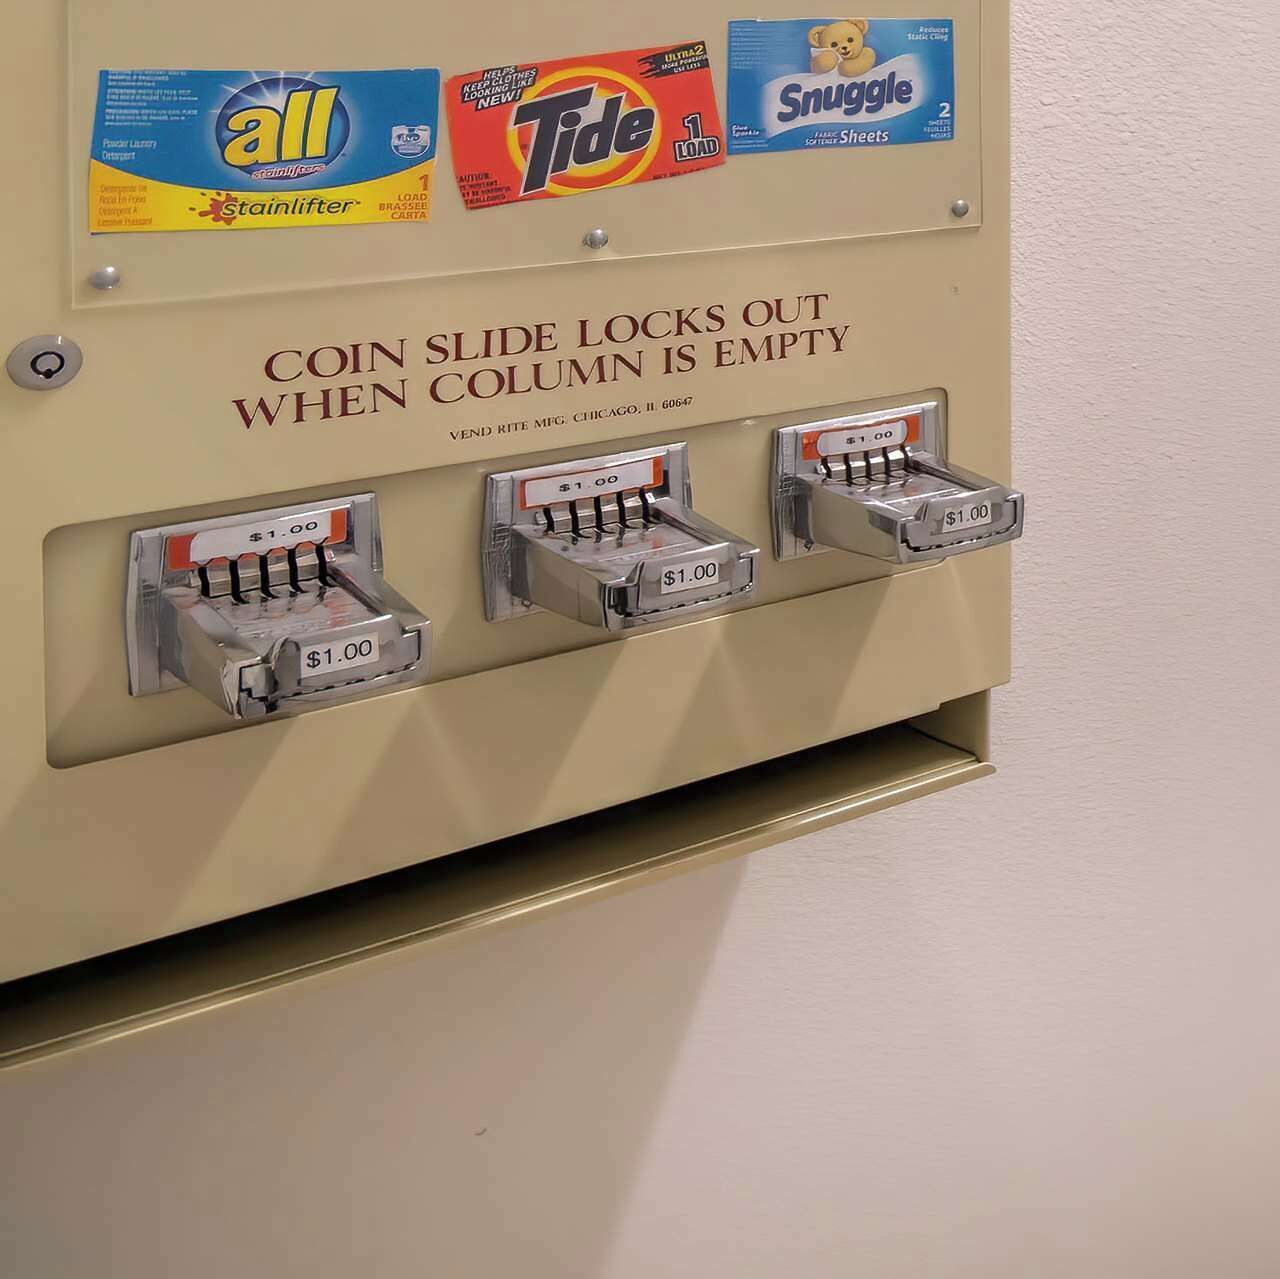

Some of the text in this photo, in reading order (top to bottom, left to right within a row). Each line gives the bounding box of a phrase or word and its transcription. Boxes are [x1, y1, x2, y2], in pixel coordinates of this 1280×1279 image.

[463, 68, 537, 94] KEEP CLOTHES
[483, 65, 517, 81] HELPS
[463, 77, 534, 102] LOOKING LIKE
[477, 90, 522, 109] NEW!
[777, 71, 913, 122] Snuggle
[939, 102, 951, 118] 2
[222, 86, 341, 168] all
[684, 113, 703, 139] 1
[839, 129, 889, 144] Sheets
[511, 82, 656, 197] Tide
[674, 137, 720, 161] LOAD
[418, 174, 430, 191] 1
[221, 197, 354, 218] stainlifter
[397, 192, 428, 202] LOAD
[264, 293, 829, 382] COIN SLIDE LOCKS OUT
[231, 325, 850, 430] WHEN COLUMN IS EMPTY
[450, 396, 694, 441] VEND RITE MFG. CHICAGO, 60647
[846, 430, 893, 445] $1.00
[559, 475, 619, 492] $1.00
[946, 504, 989, 526] $1.00
[249, 521, 319, 542] $1.00
[663, 562, 717, 587] $1.00
[306, 639, 373, 669] $1.00
